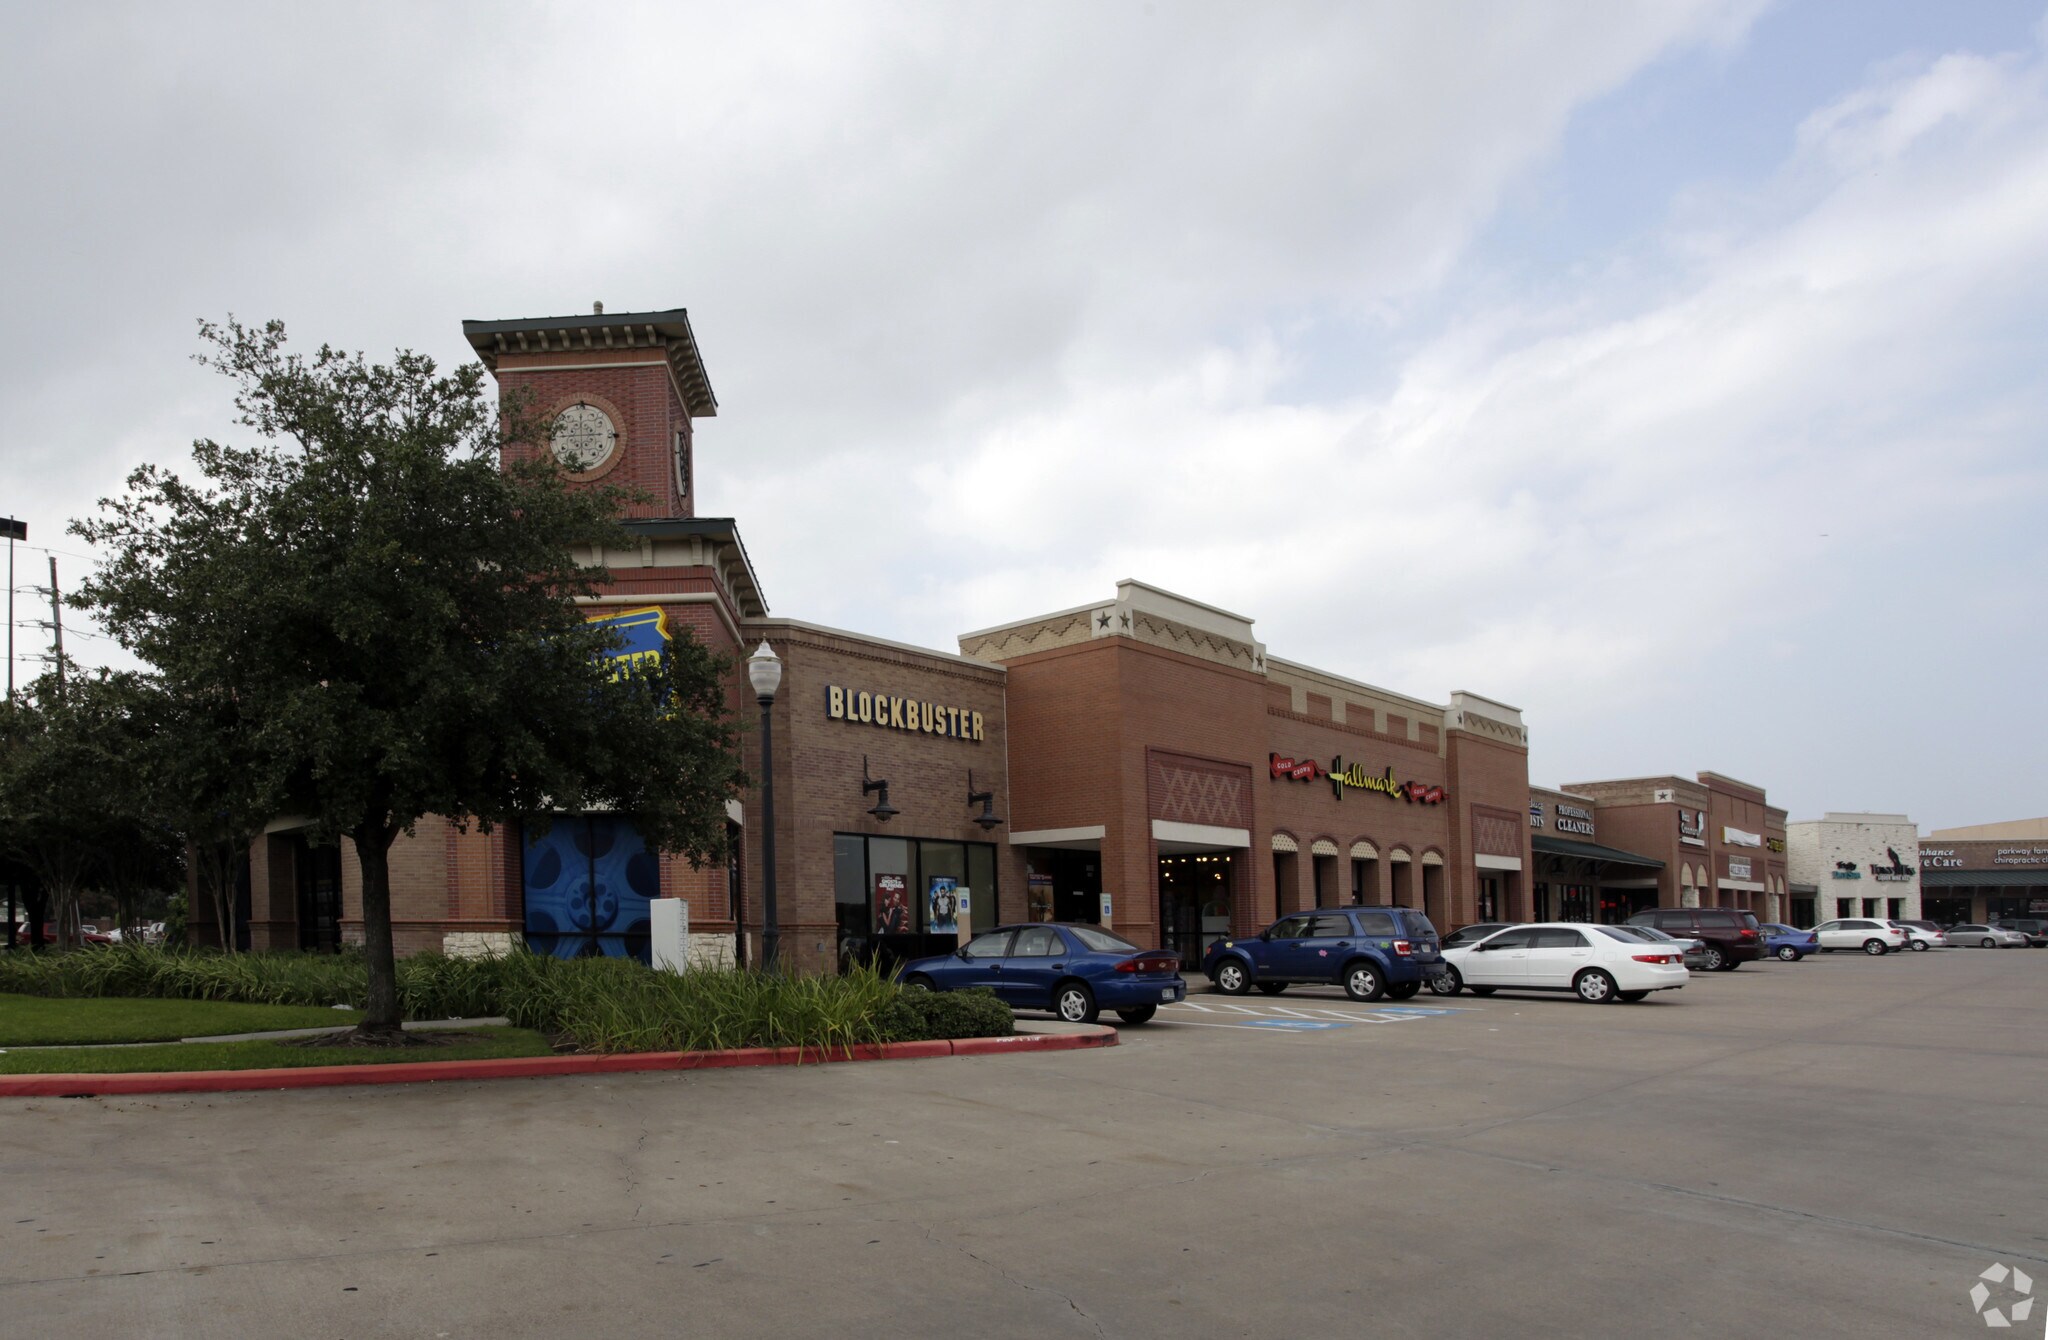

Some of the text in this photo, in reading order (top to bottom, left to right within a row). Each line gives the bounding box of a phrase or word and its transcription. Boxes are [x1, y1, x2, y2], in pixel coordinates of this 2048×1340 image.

[827, 685, 984, 741] BLOCKBUSTER
[1329, 755, 1402, 801] Hallmark
[1557, 804, 1592, 820] PROFESSIONAL
[1557, 818, 1595, 835] CLEANERS
[1997, 848, 2030, 856] parkway
[1932, 856, 1963, 867] Care
[1993, 856, 2041, 866] chiropractic
